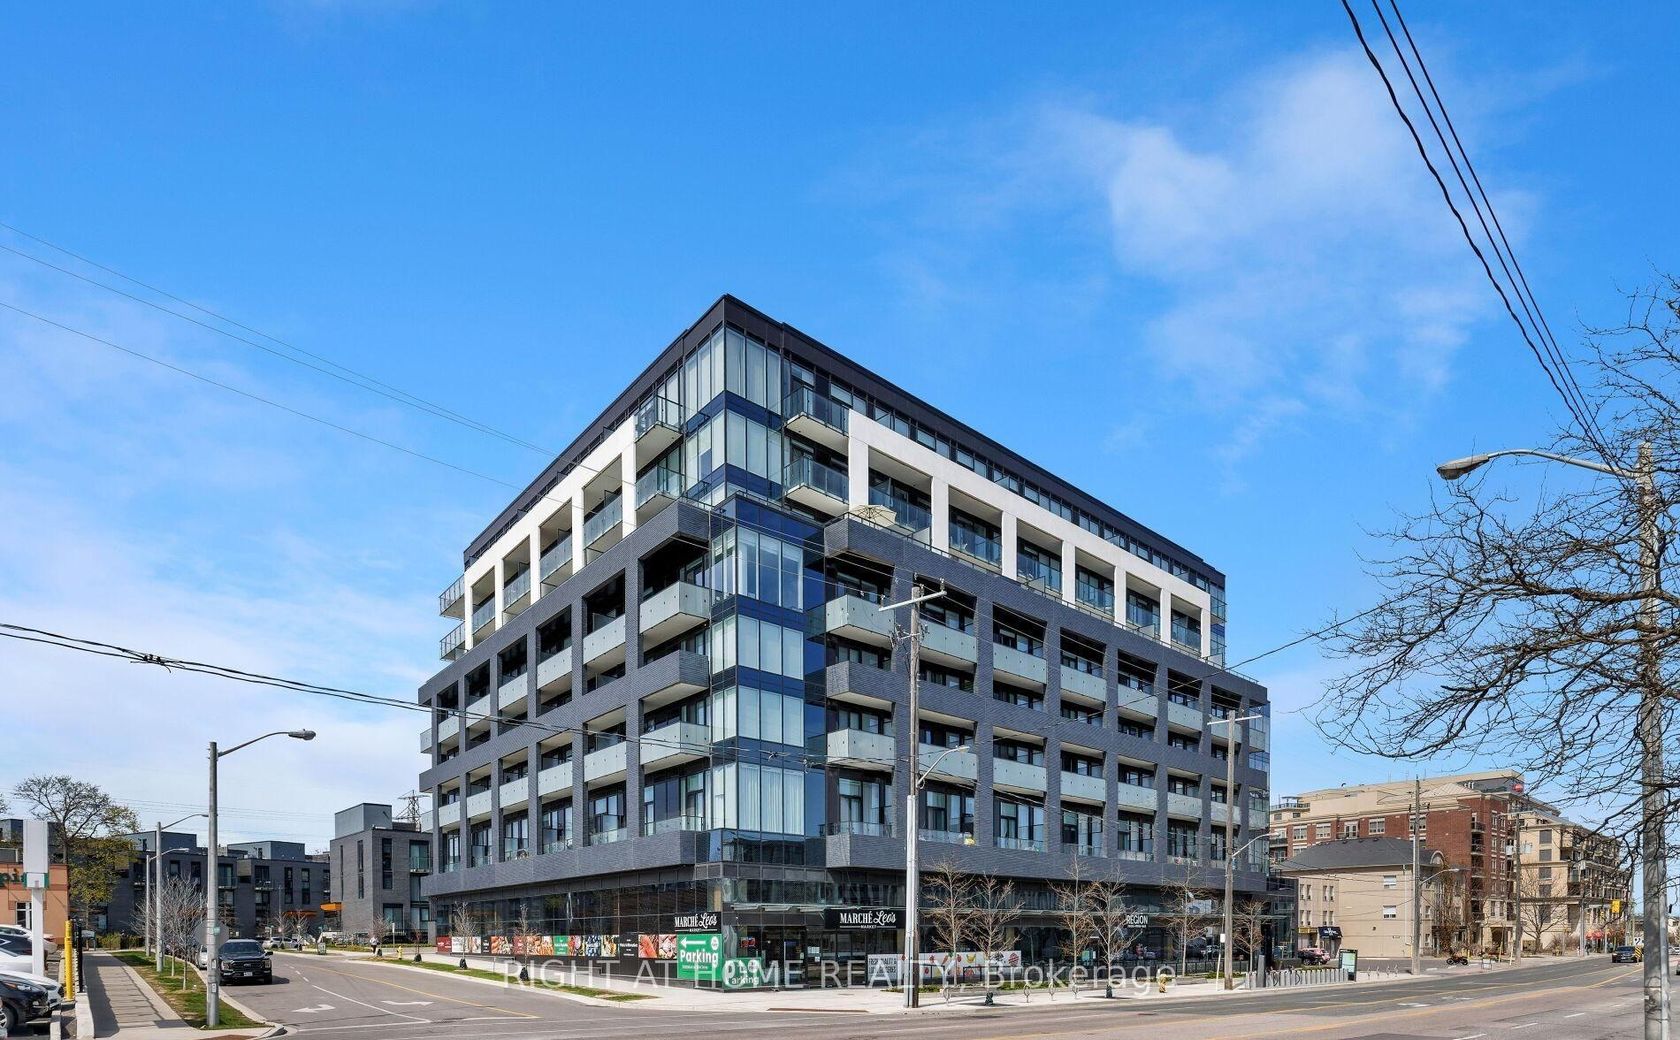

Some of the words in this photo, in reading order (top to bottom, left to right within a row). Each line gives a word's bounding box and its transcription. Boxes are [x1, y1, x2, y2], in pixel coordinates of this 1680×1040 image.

[674, 913, 698, 928] MARCHÉ
[698, 912, 718, 928] Leo's
[840, 911, 873, 924] MARCHÉ
[873, 910, 896, 926] Leo's
[680, 949, 718, 966] Parking
